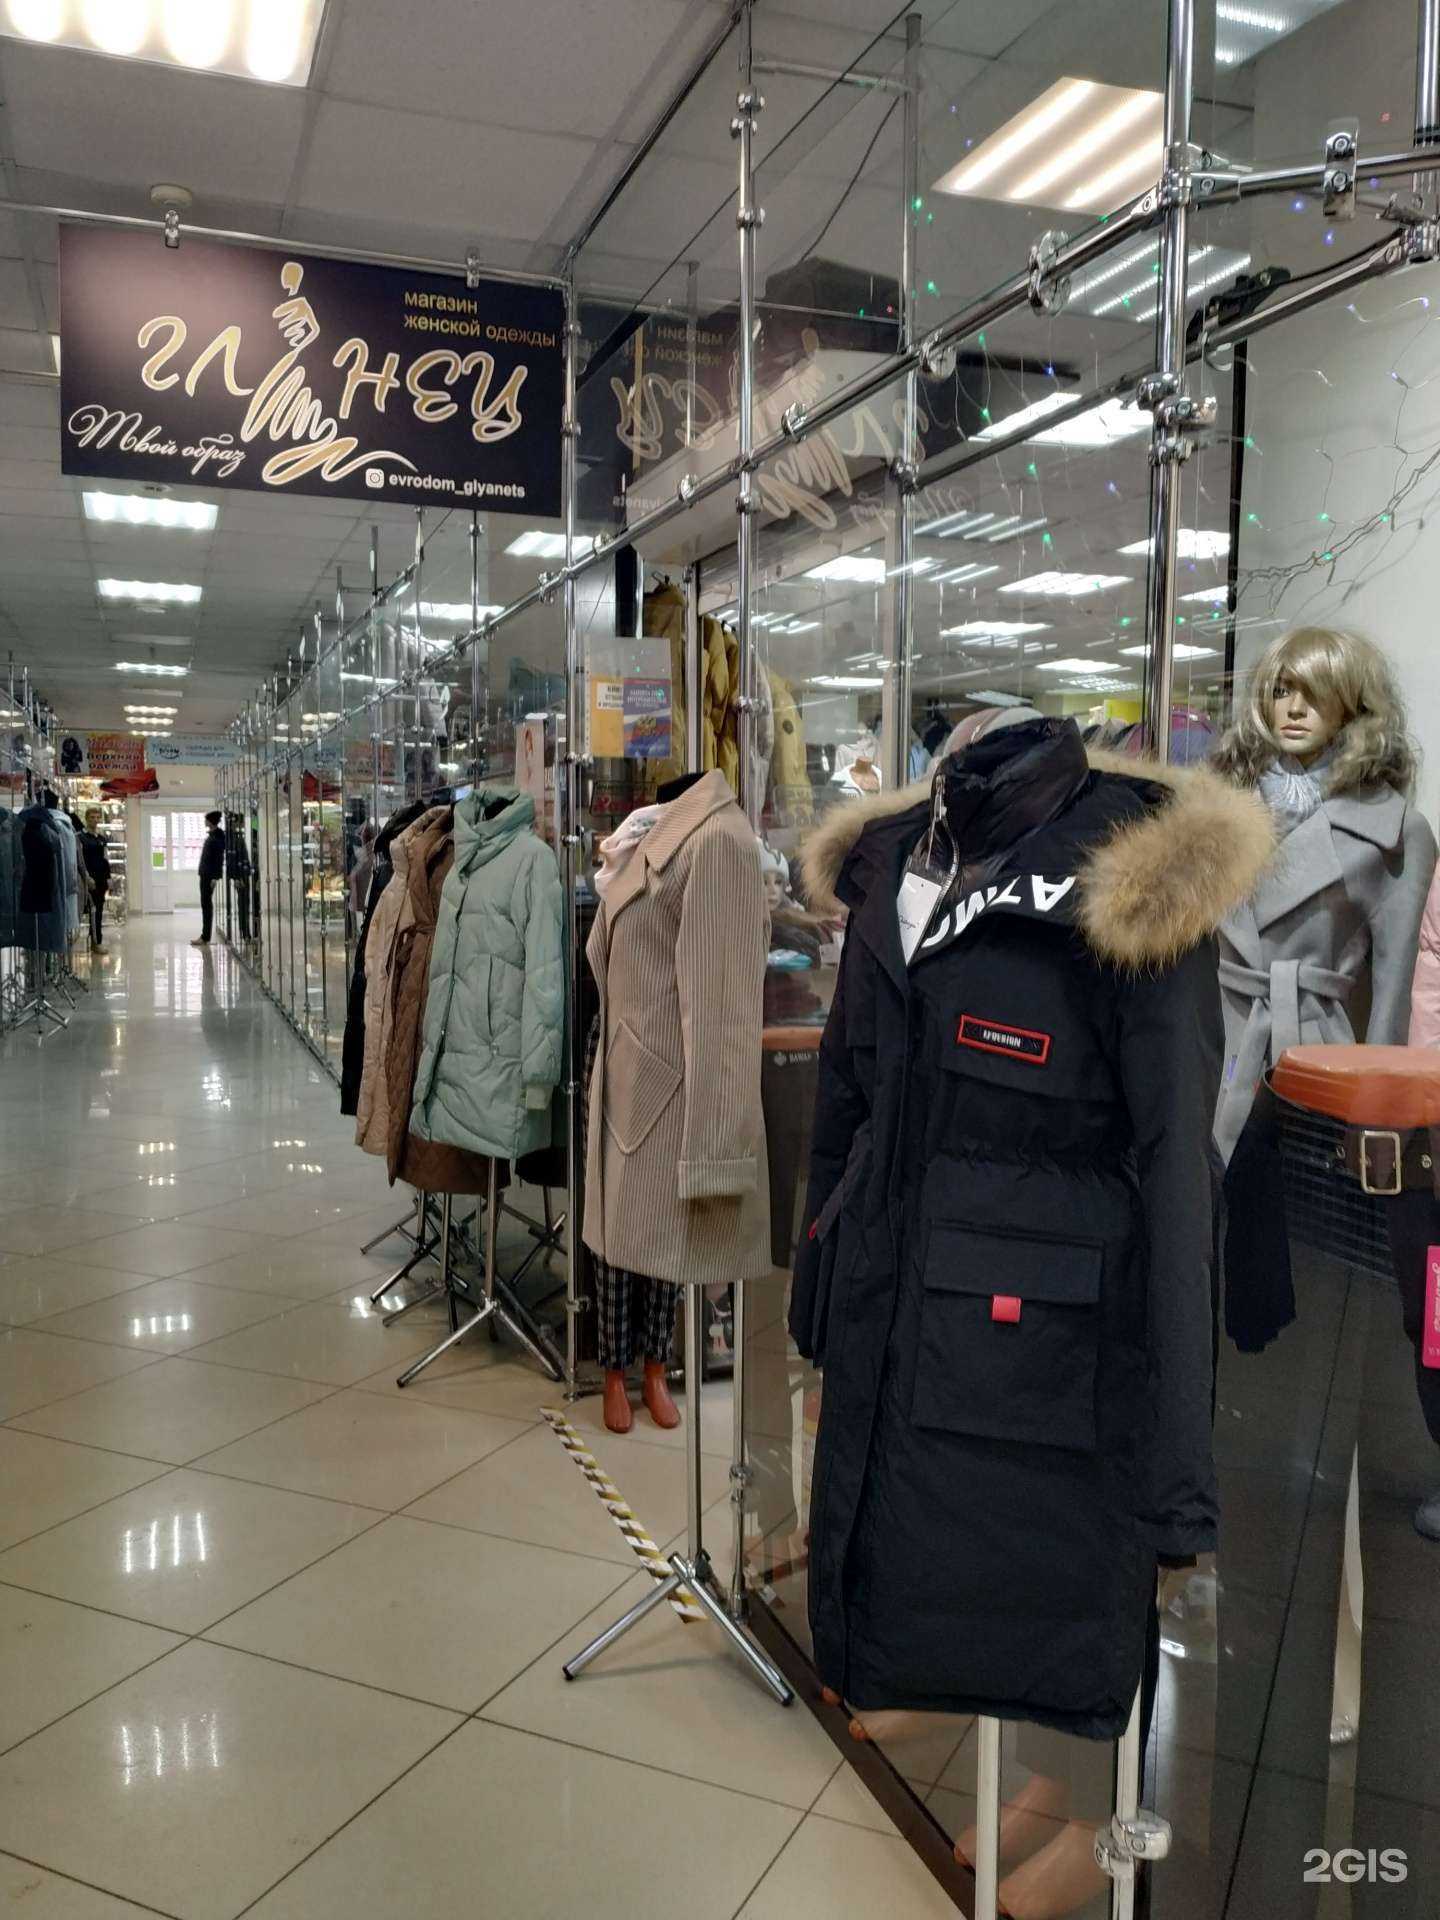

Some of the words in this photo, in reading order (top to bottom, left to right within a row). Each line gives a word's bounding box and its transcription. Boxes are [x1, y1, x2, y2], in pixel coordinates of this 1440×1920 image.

[404, 291, 478, 314] магазин
[404, 314, 480, 337] женской
[486, 324, 556, 348] одежды
[68, 404, 178, 456] Твой
[181, 433, 247, 478] образ
[388, 473, 526, 498] evrodom_glyanets
